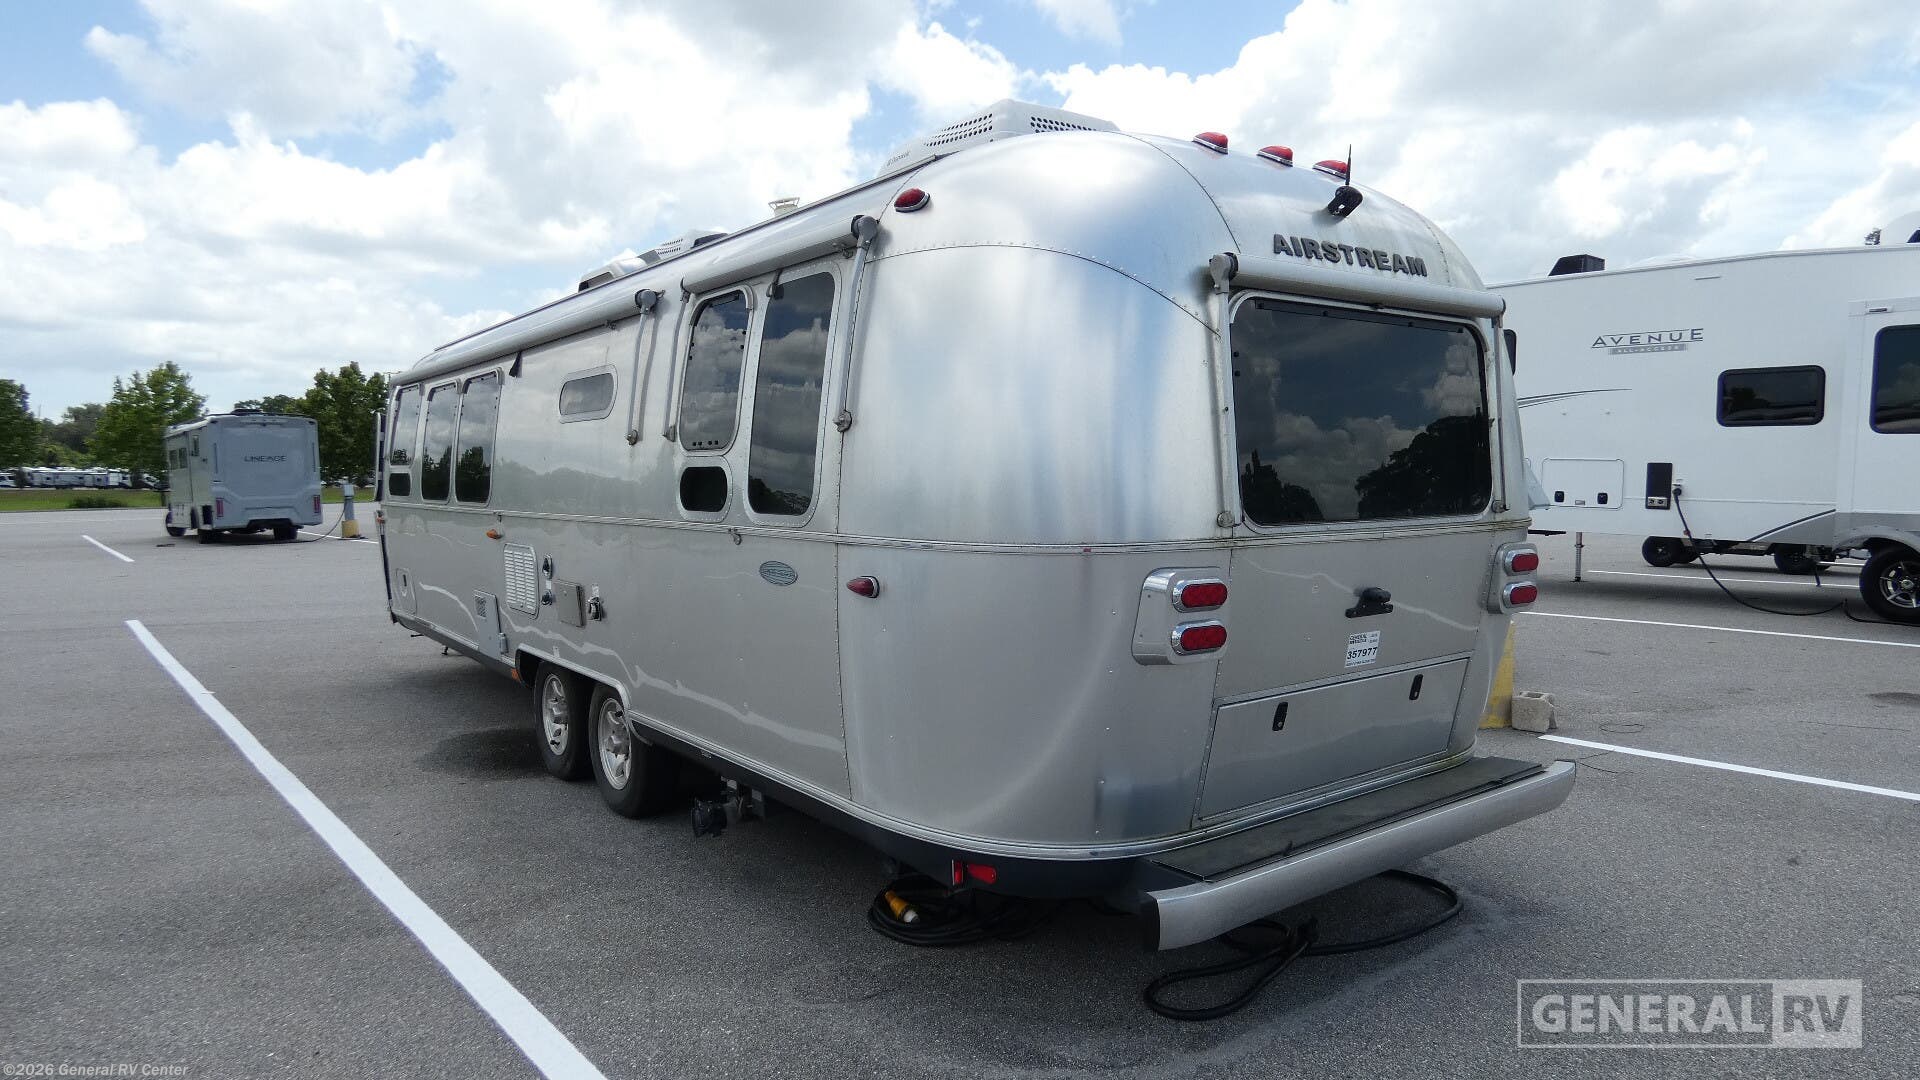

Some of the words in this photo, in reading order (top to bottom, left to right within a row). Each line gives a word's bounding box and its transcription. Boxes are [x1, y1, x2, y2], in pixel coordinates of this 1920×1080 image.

[1273, 233, 1428, 277] AIRSTREAM
[1592, 328, 1704, 347] AVENUE
[1346, 646, 1378, 660] 357977
